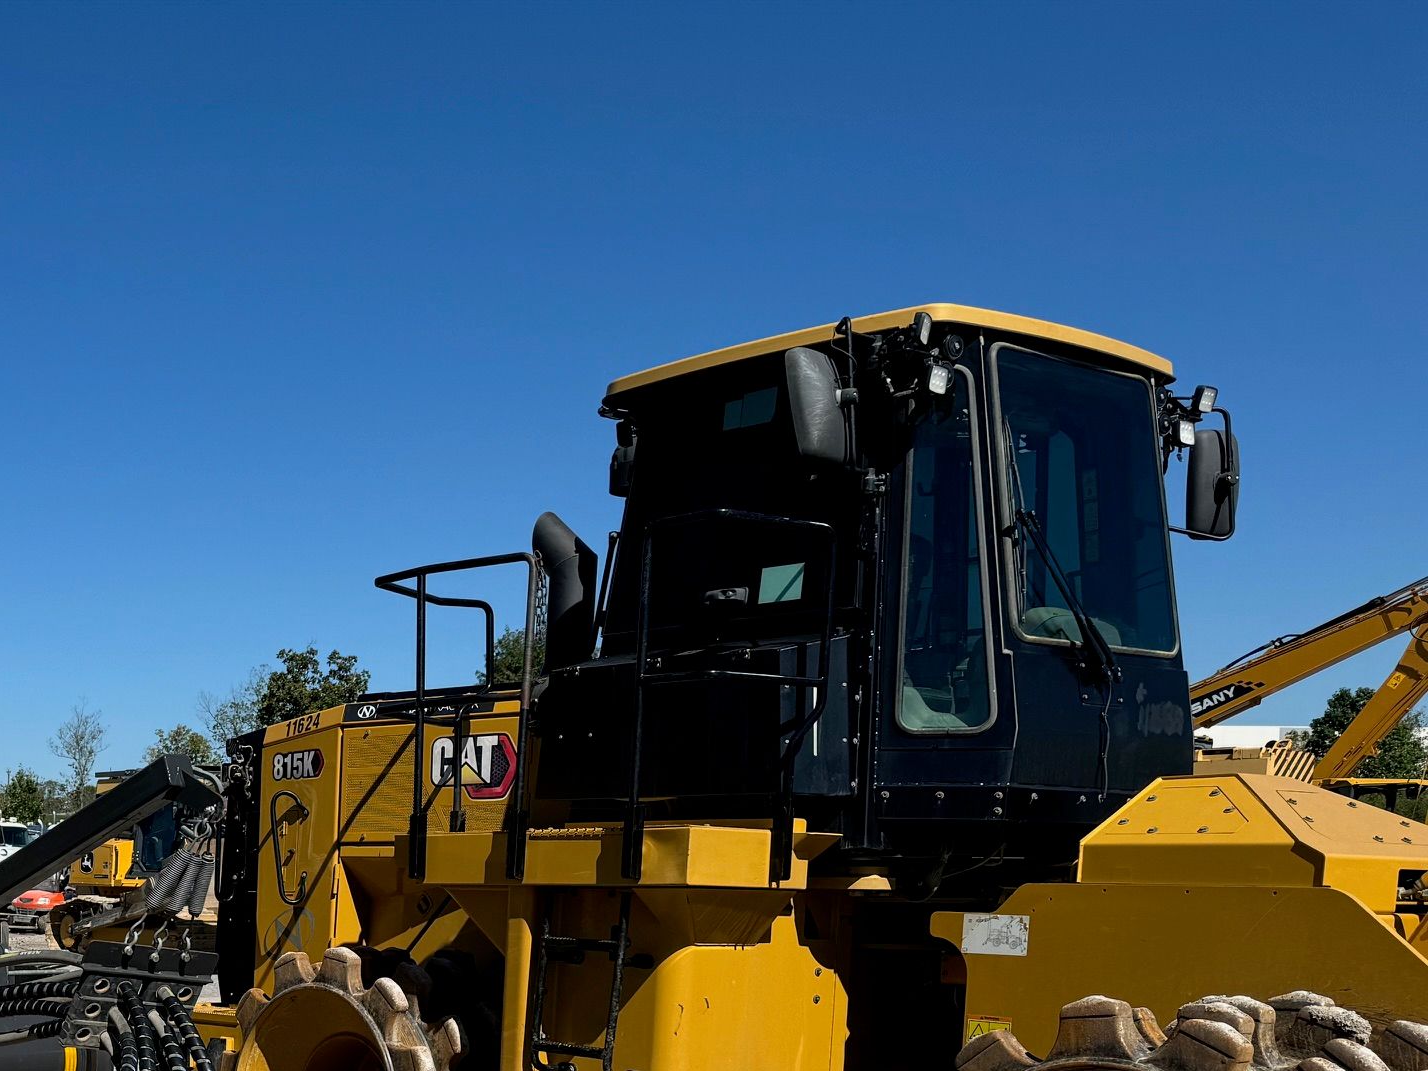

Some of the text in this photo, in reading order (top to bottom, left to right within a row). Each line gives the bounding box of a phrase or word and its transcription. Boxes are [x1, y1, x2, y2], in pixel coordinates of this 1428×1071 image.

[1191, 685, 1237, 715] SANY
[285, 713, 321, 738] 11624
[273, 750, 315, 780] 815K
[432, 734, 499, 786] CAT
